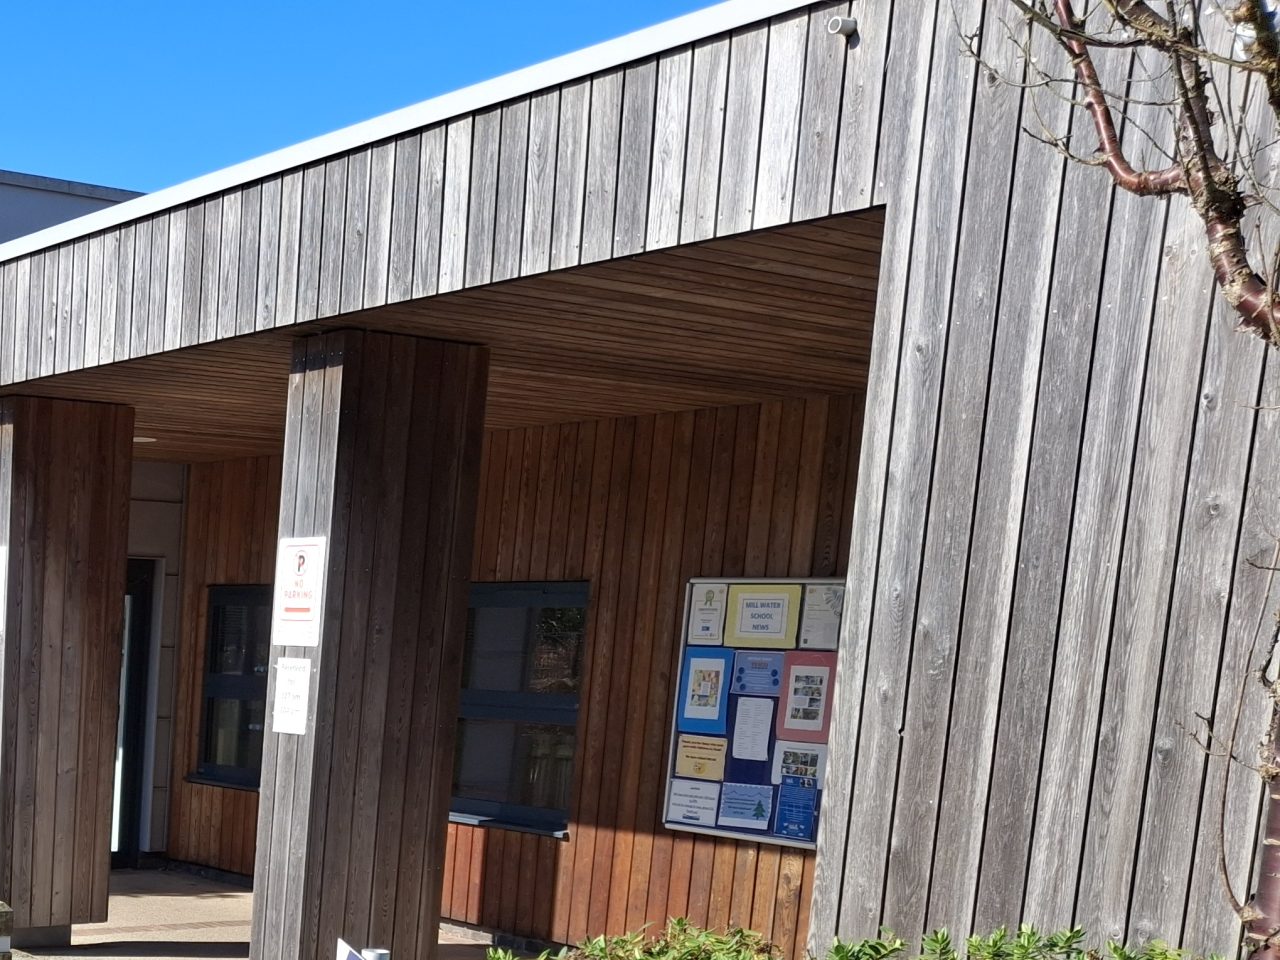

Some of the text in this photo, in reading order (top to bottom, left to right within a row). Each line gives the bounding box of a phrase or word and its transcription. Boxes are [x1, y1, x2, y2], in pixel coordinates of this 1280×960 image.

[294, 580, 305, 589] NO
[284, 590, 313, 600] PARKING
[750, 612, 773, 620] SCHOOL
